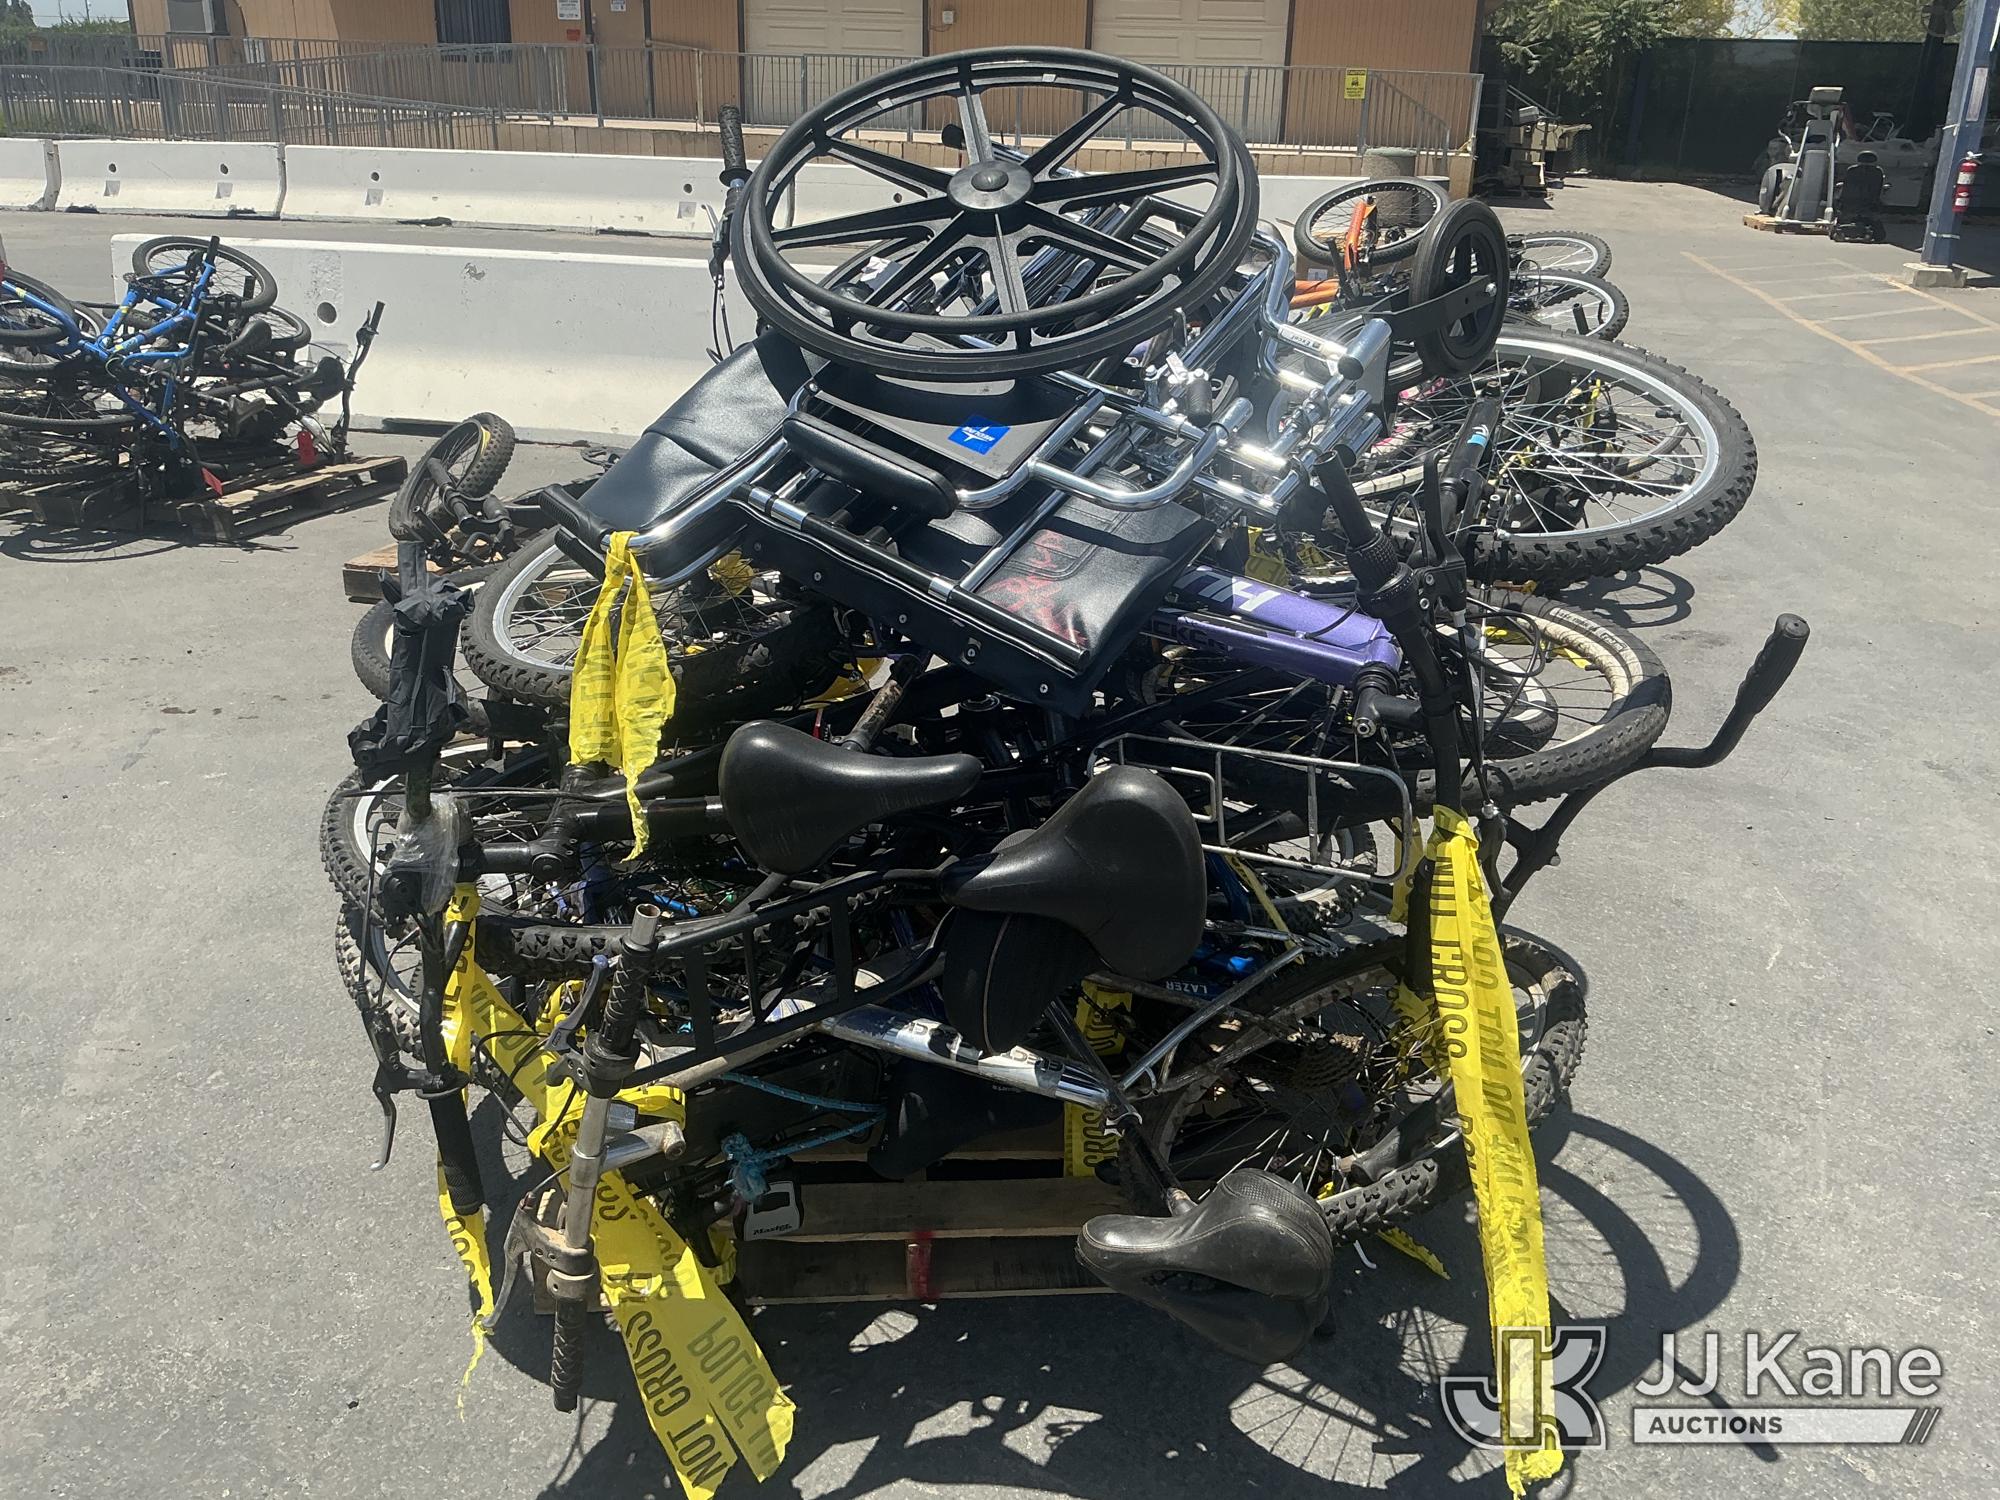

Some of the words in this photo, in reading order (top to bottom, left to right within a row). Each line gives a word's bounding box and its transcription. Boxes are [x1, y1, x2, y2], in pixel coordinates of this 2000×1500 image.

[1166, 981, 1208, 994] LAZER
[624, 1308, 691, 1418] CROSS
[667, 1416, 728, 1490] NOT
